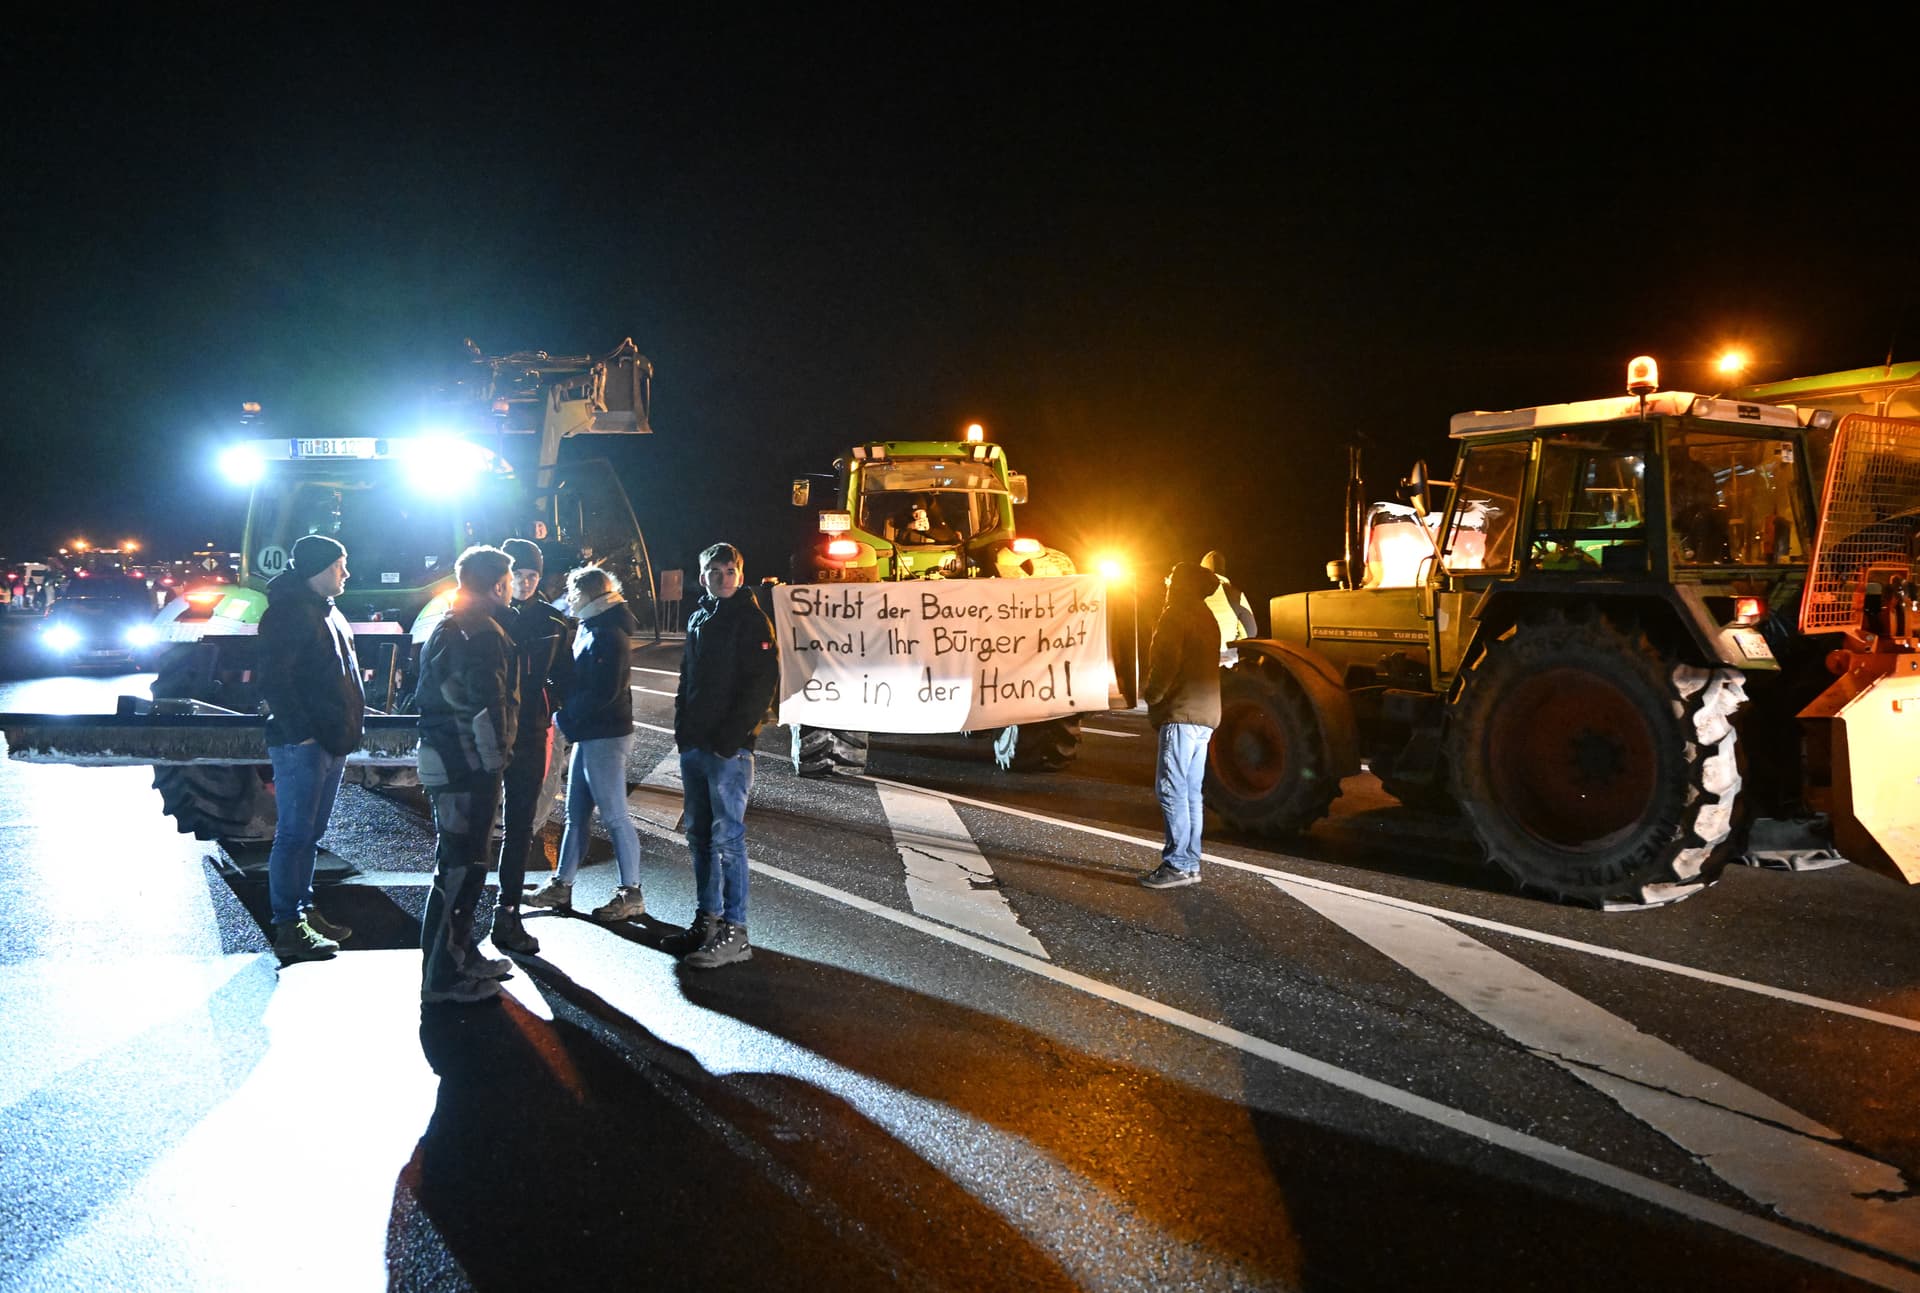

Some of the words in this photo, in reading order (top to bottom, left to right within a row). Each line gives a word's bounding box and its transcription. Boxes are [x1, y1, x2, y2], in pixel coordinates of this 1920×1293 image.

[298, 440, 313, 454] TÜ
[322, 440, 338, 454] BI
[263, 550, 282, 570] 40
[790, 588, 864, 619] Stirbt
[877, 593, 911, 619] der
[921, 592, 993, 622] Bauer,
[997, 592, 1055, 619] stirbt
[1067, 588, 1099, 613] das
[792, 627, 865, 657] Land!
[888, 628, 920, 655] Ihr
[933, 626, 1026, 662] Bürger
[1037, 620, 1087, 653] habt
[803, 678, 841, 702] es
[863, 674, 892, 707] in
[918, 666, 960, 703] der
[980, 660, 1075, 707] Hand!
